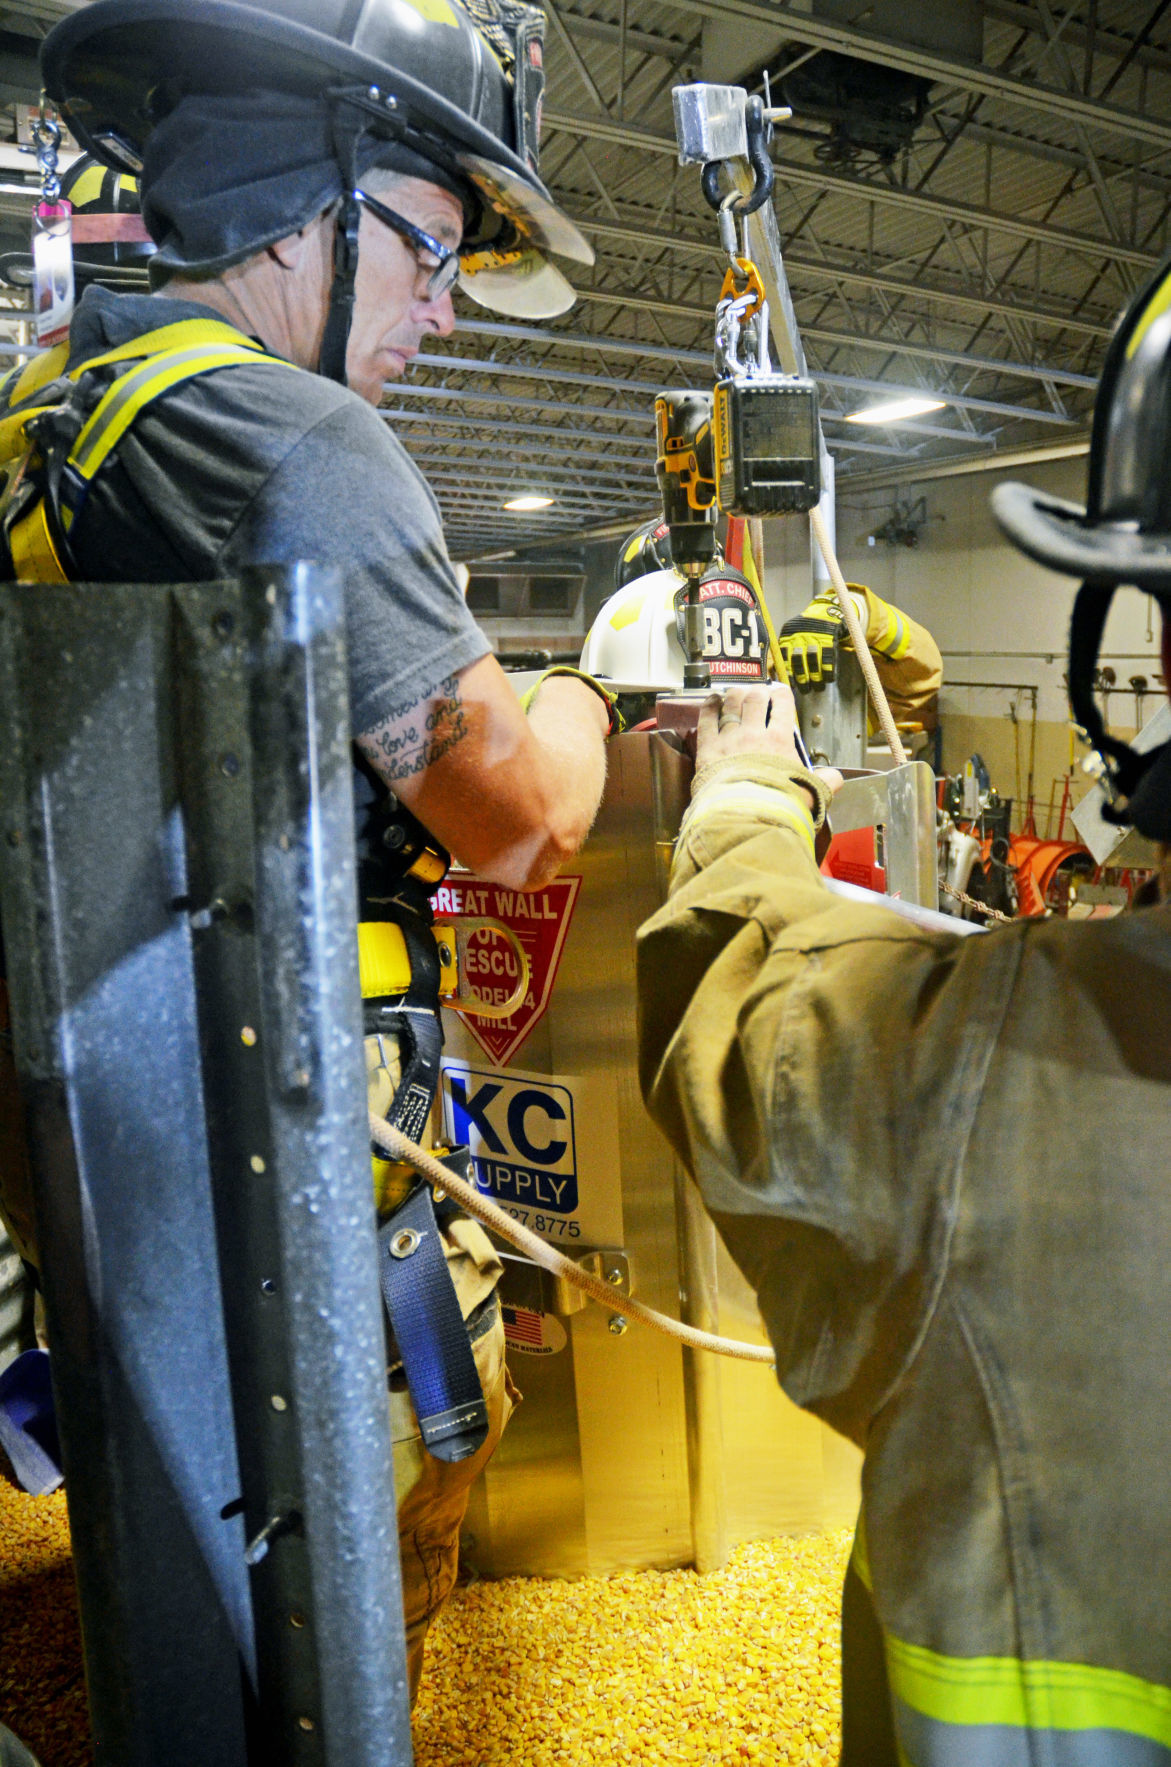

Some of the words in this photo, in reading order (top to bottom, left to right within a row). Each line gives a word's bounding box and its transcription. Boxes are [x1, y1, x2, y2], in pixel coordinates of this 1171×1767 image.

[700, 582, 725, 599] ATT.
[702, 607, 762, 658] BC-1
[709, 661, 758, 674] UTCHINSON
[495, 891, 558, 920] WALL
[465, 948, 534, 979] ESCUE
[450, 1077, 568, 1165] KC
[473, 1160, 568, 1205] UPPLY
